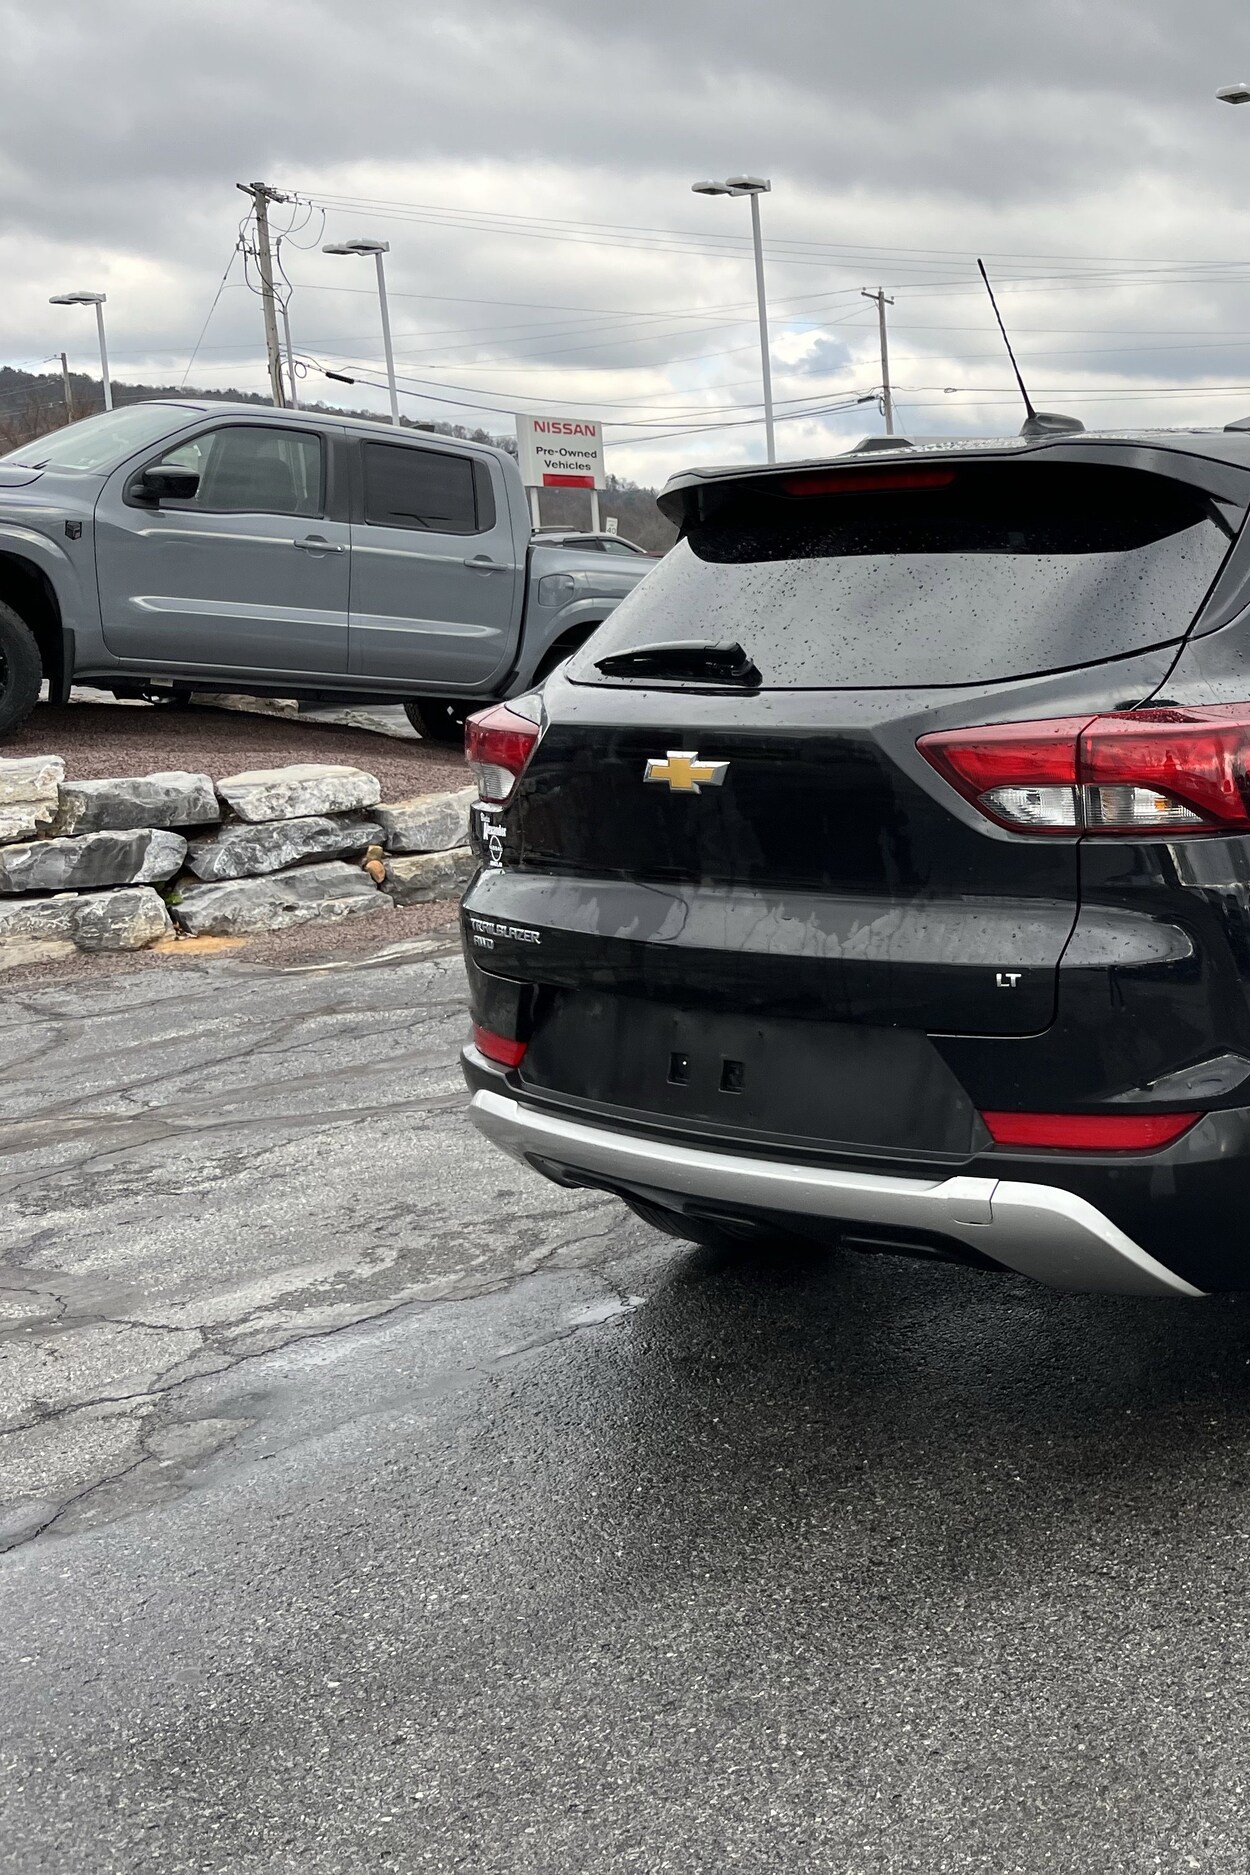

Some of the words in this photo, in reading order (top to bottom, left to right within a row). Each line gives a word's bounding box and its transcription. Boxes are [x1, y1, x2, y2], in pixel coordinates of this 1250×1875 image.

[534, 420, 596, 437] NISSAN
[536, 446, 597, 458] Pre-Owned
[544, 460, 591, 471] Vehicles
[470, 918, 542, 944] TRAILBLAZER
[996, 973, 1022, 988] LT
